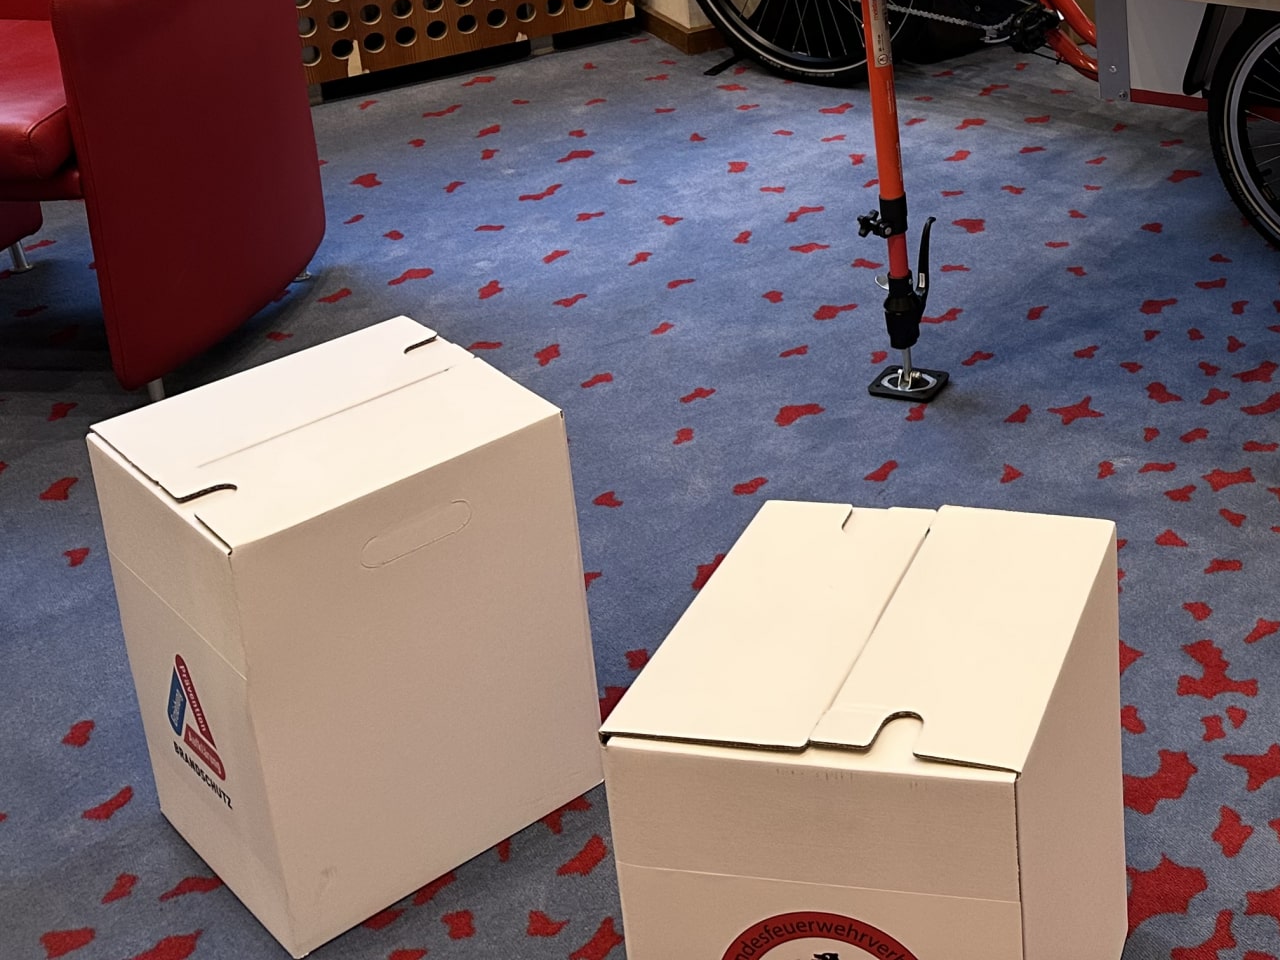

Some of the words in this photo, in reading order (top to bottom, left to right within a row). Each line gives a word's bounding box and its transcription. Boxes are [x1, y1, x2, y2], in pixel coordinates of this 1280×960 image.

[179, 665, 207, 732] Prävention
[173, 740, 233, 811] BRANDSCHUTZ
[735, 920, 907, 960] ndesfeuerwehrver
